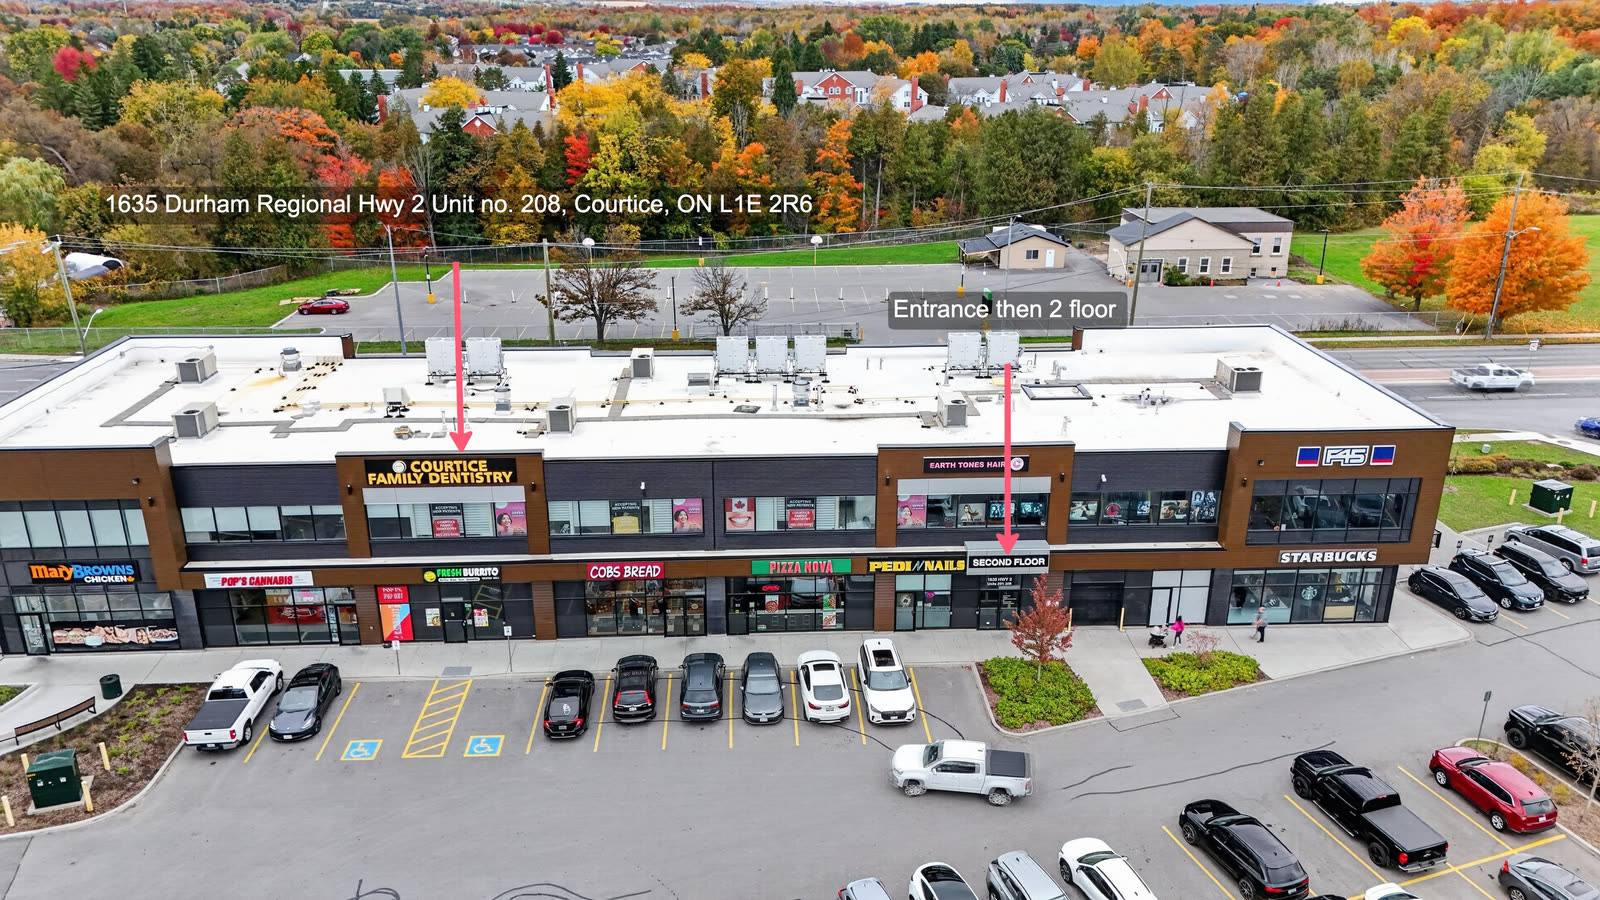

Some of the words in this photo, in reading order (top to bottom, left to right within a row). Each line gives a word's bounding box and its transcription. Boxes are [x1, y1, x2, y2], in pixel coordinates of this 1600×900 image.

[1324, 447, 1367, 465] F45
[410, 460, 488, 472] COURTICE
[368, 472, 424, 484] FAMILY
[428, 472, 513, 484] DENTISTRY
[972, 558, 1012, 567] SECOND
[1280, 551, 1377, 563] STARBUCKS
[436, 568, 462, 577] FRESH
[462, 567, 499, 577] BURRITO
[590, 566, 621, 578] COBS
[623, 565, 661, 577] BREAD
[769, 561, 801, 574] PIZZA
[804, 560, 833, 573] NOVA
[869, 560, 912, 572] PEDI
[924, 560, 965, 571] NAILS
[221, 576, 247, 586] POP'S
[249, 575, 293, 586] CANNABIS
